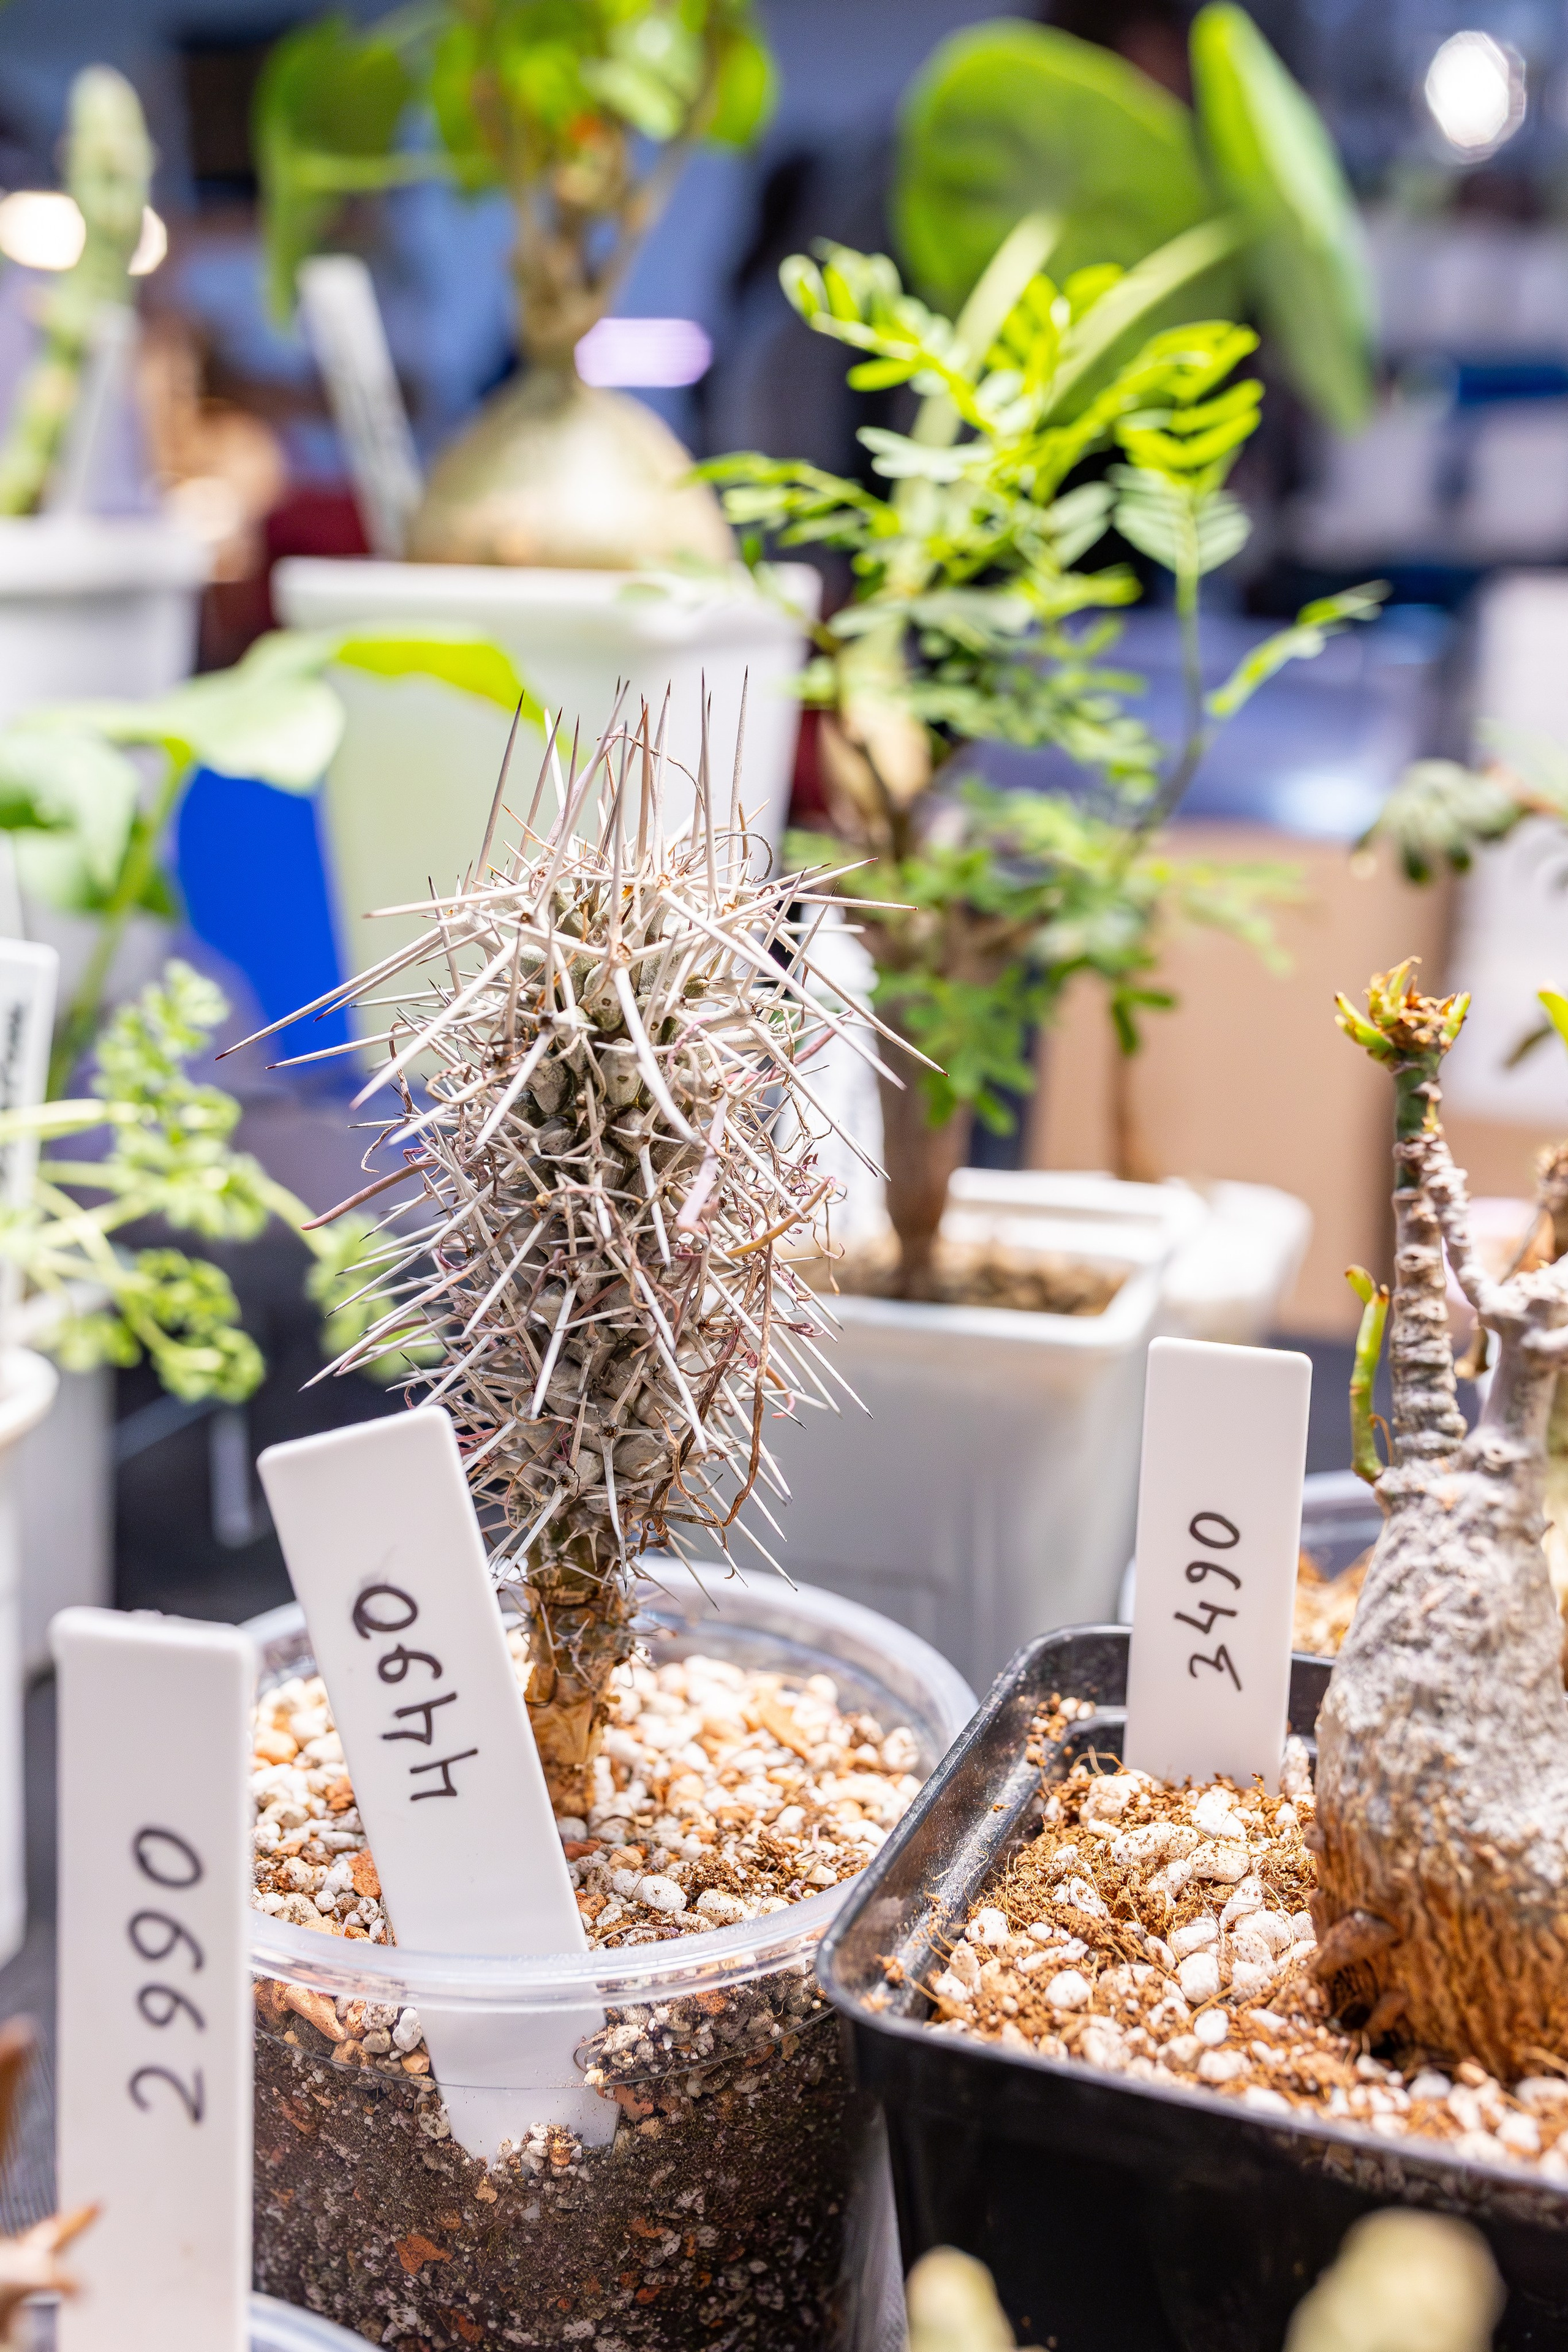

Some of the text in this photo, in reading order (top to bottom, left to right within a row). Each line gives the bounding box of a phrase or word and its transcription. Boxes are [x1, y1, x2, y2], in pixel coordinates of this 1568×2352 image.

[352, 1583, 478, 1801] 4490
[1174, 1511, 1242, 1692] 3490
[126, 1824, 206, 2125] 2990
